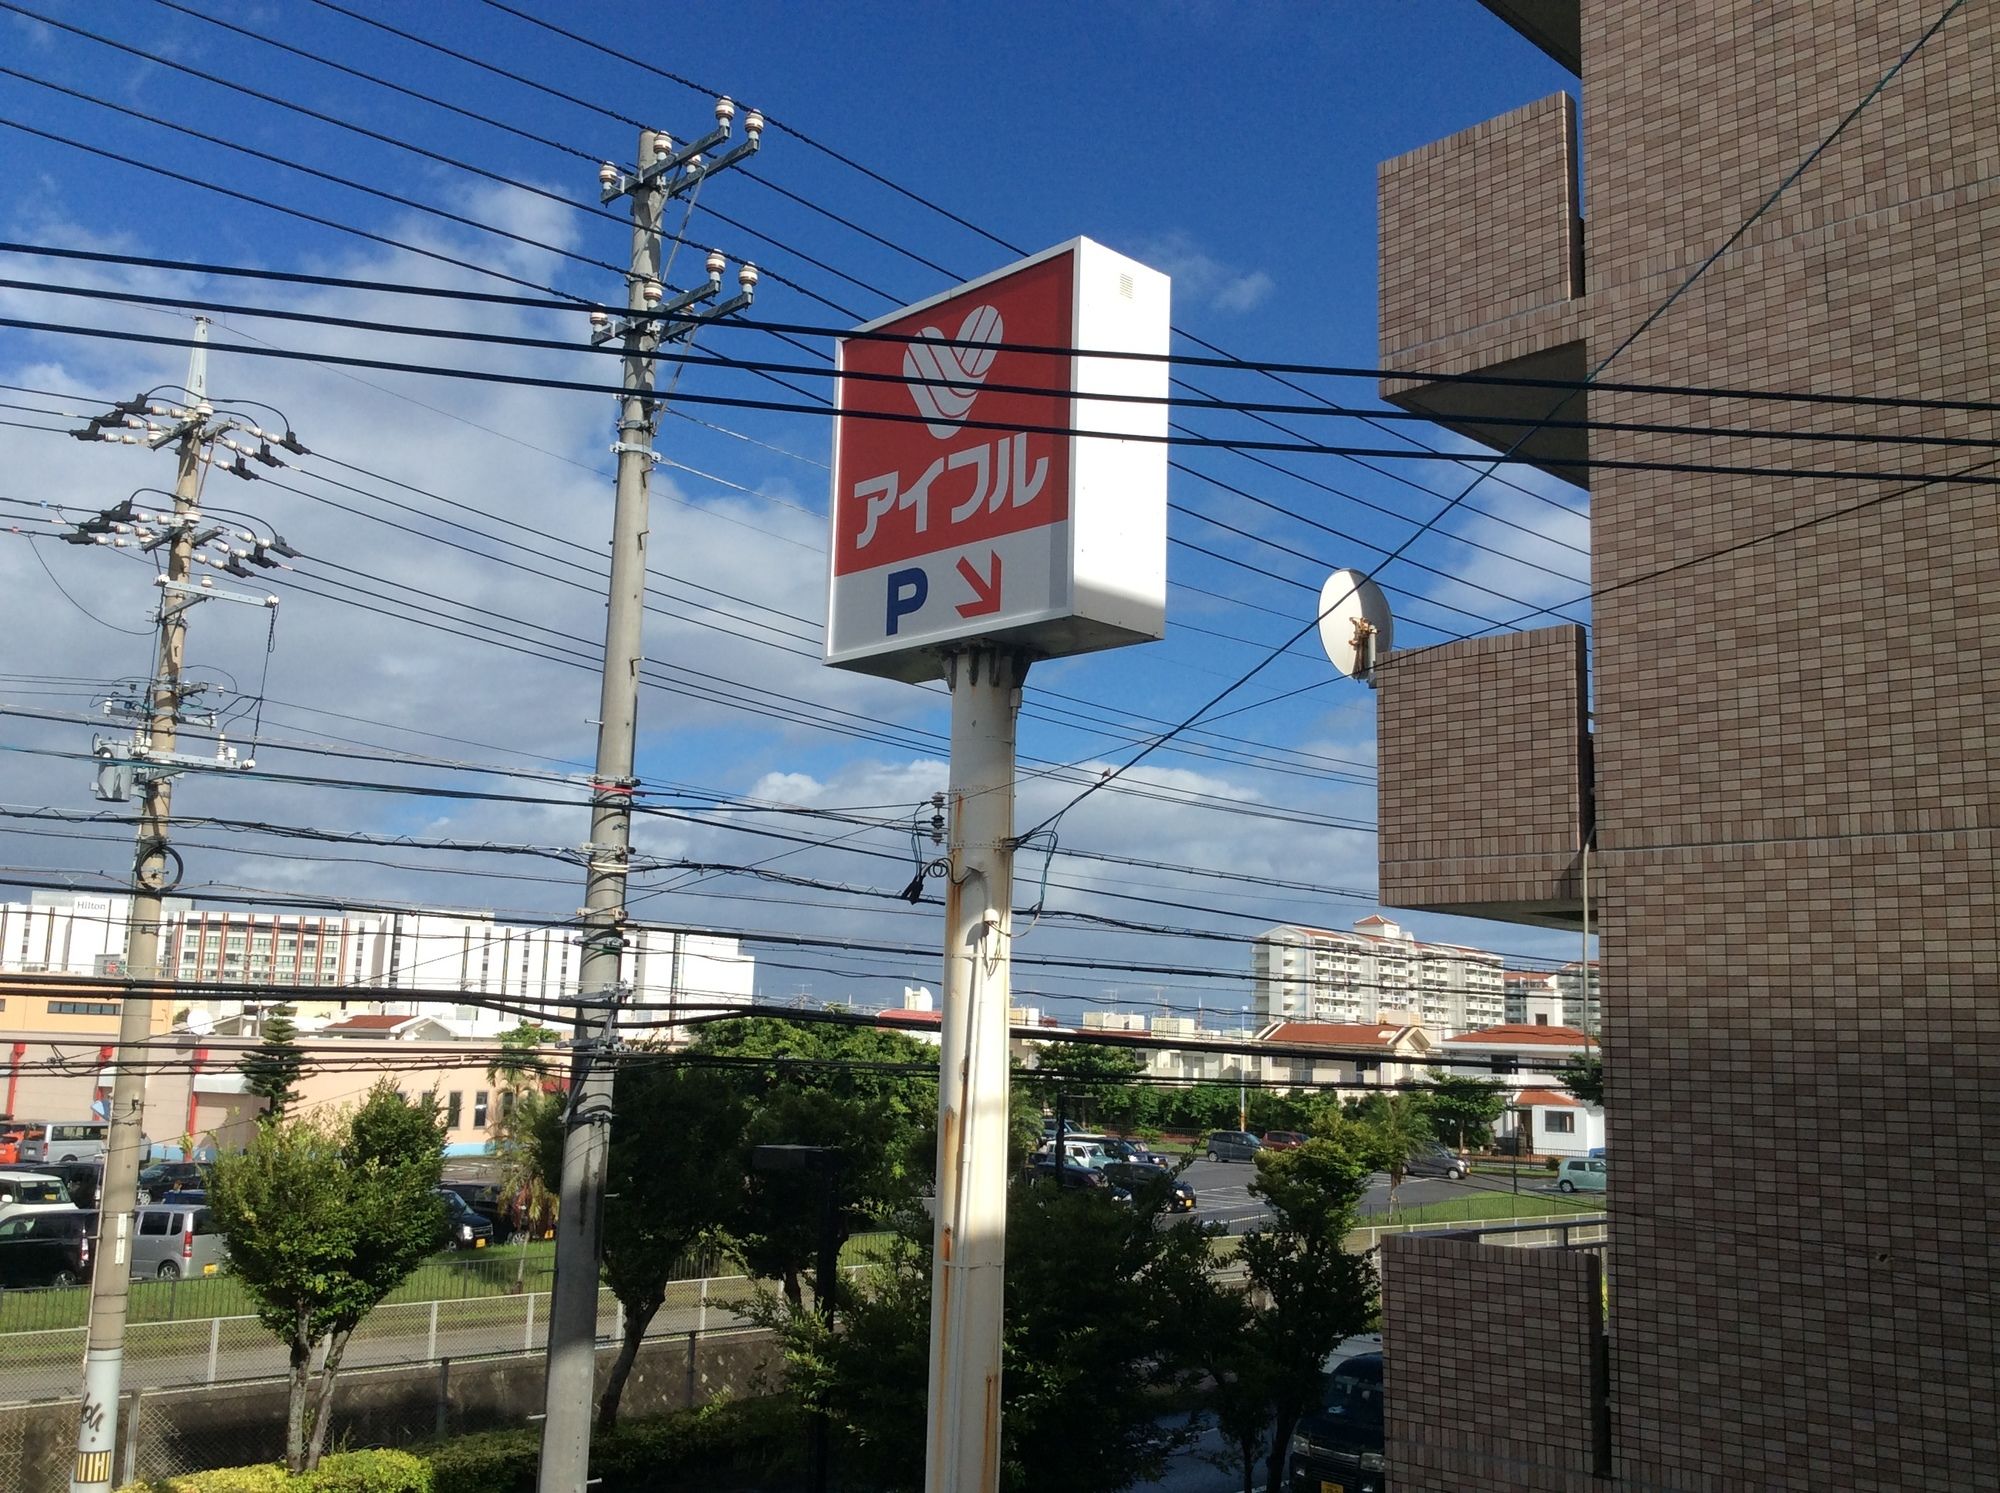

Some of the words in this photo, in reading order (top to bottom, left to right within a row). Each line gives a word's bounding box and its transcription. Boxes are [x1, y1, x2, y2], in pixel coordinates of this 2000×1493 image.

[854, 432, 1049, 549] アイフル
[886, 567, 928, 636] P
[77, 901, 106, 910] Hilton
